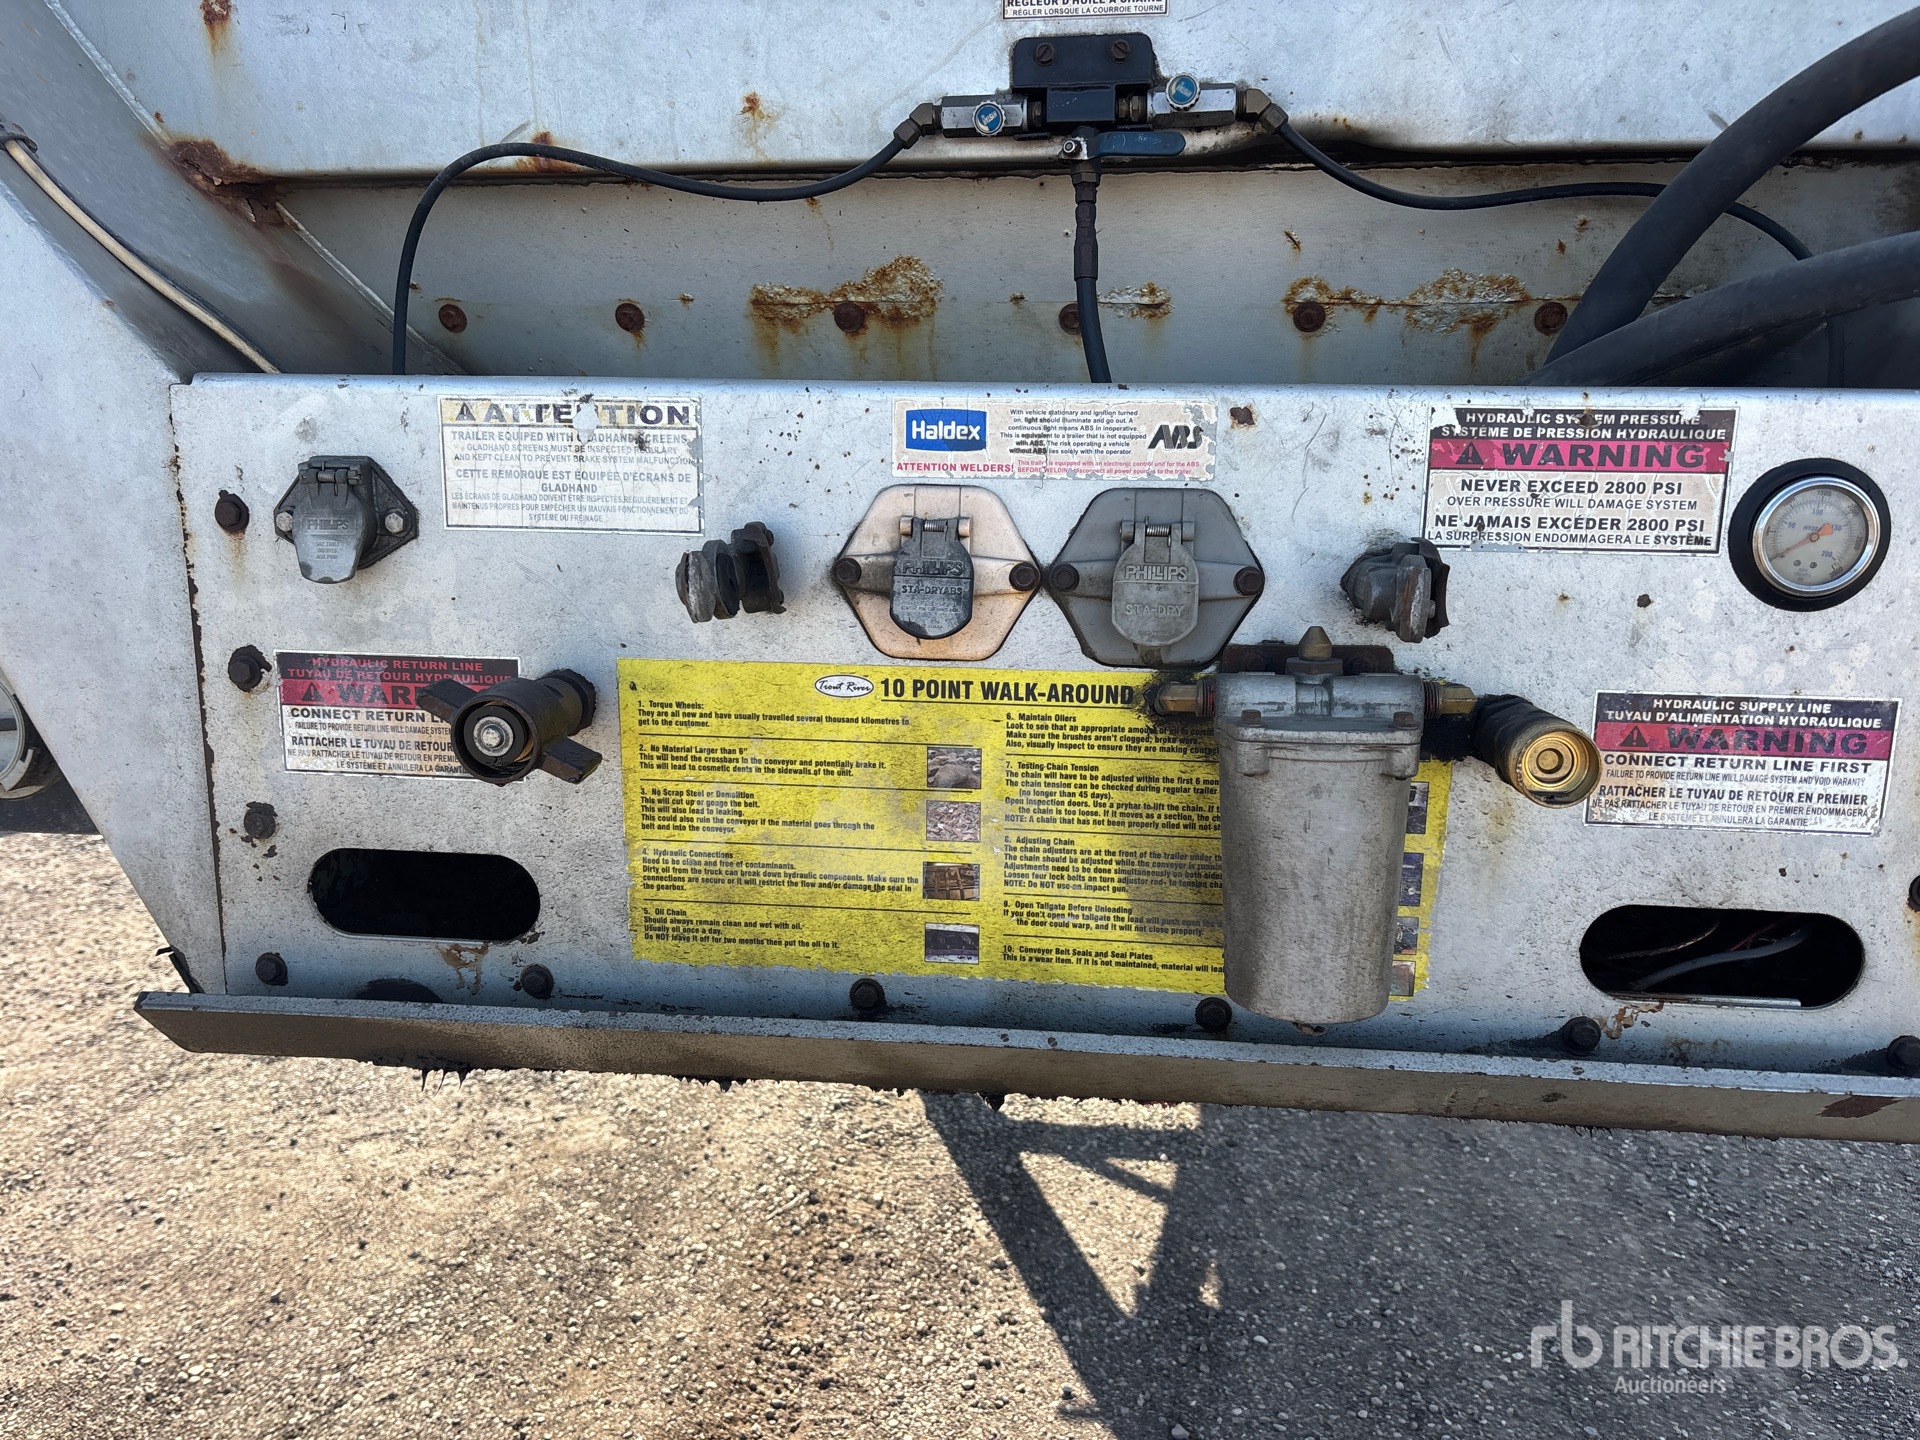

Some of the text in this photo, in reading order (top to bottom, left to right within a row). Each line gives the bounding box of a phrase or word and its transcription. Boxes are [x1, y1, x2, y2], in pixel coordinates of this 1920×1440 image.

[1013, 8, 1042, 16] RÉGLER
[484, 404, 690, 425] ATTETION
[1466, 413, 1551, 424] HYDRAULIC
[451, 431, 495, 440] TRAILER
[547, 432, 573, 441] WITH
[912, 420, 980, 440] Haldex
[1514, 428, 1531, 437] DE
[1536, 428, 1611, 438] PRESSION
[1616, 429, 1726, 440] HYDRAULIQUE
[1502, 444, 1704, 468] WARNING
[897, 463, 1014, 472] ATTENTION WELDERS!
[456, 469, 488, 478] CETTE
[492, 469, 549, 479] REMORQUE
[552, 471, 574, 479] EST
[678, 474, 691, 482] DE
[541, 483, 598, 492] GLADHAND
[1461, 479, 1682, 494] NEVER EXCEED 2800 PSI
[1447, 496, 1697, 510] OVER PRESSURE WILL DAMAGE SYSTEM
[307, 518, 349, 531] PHILLIPS
[1435, 515, 1704, 532] NE JAMAIS EXCÉDER 2800 PSI
[1428, 530, 1712, 546] LA SURPRESSION ENDOMMAGERA LE SYSTÈME
[902, 560, 963, 575] PHILLIPS
[1125, 565, 1188, 581] PHILLIPS
[1126, 604, 1185, 616] STA-DRY
[312, 658, 483, 671] HYDRAULIC RETURN LINE
[288, 669, 331, 677] TUYAU
[336, 670, 352, 679] DE
[357, 672, 410, 681] RETOUR
[880, 678, 905, 698] 10
[912, 678, 974, 700] POINT
[981, 681, 1134, 705] WALK-AROUND
[649, 700, 673, 709] Torque
[675, 701, 704, 709] Wheels:
[1653, 699, 1831, 713] HYDRAULIC SUPPLY LINE
[291, 708, 426, 722] CONNECT RETURN
[1019, 713, 1052, 721] Maintain
[1055, 714, 1076, 722] Oilers
[1606, 711, 1881, 728] TUYAU D'ALIMENTATION HYDRAULIQUE
[292, 736, 347, 747] RATTACHER
[350, 739, 361, 748] LE
[364, 739, 396, 749] TUYAU
[399, 741, 412, 749] DE
[1667, 727, 1867, 755] WARNING
[662, 745, 692, 753] Material
[695, 746, 717, 755] Larger
[1018, 762, 1044, 771] Testing
[1046, 763, 1068, 771] Chain
[1071, 764, 1099, 772] Tension
[1604, 754, 1872, 773] CONNECT RETURN LINE FIRST
[1607, 769, 1634, 778] FAILURE
[1635, 770, 1644, 778] TO
[1646, 771, 1675, 780] PROVIDE
[1033, 789, 1056, 798] longer
[1598, 785, 1868, 805] RATTACHER LE TUYAU DE RETOUR EN PREMIER
[1015, 901, 1034, 909] Open
[1036, 902, 1065, 910] Tailgate
[1068, 904, 1093, 912] Before
[1019, 946, 1053, 955] Conveyor
[1072, 948, 1092, 956] Seals
[1111, 950, 1127, 958] Seal
[1129, 951, 1153, 960] Plates
